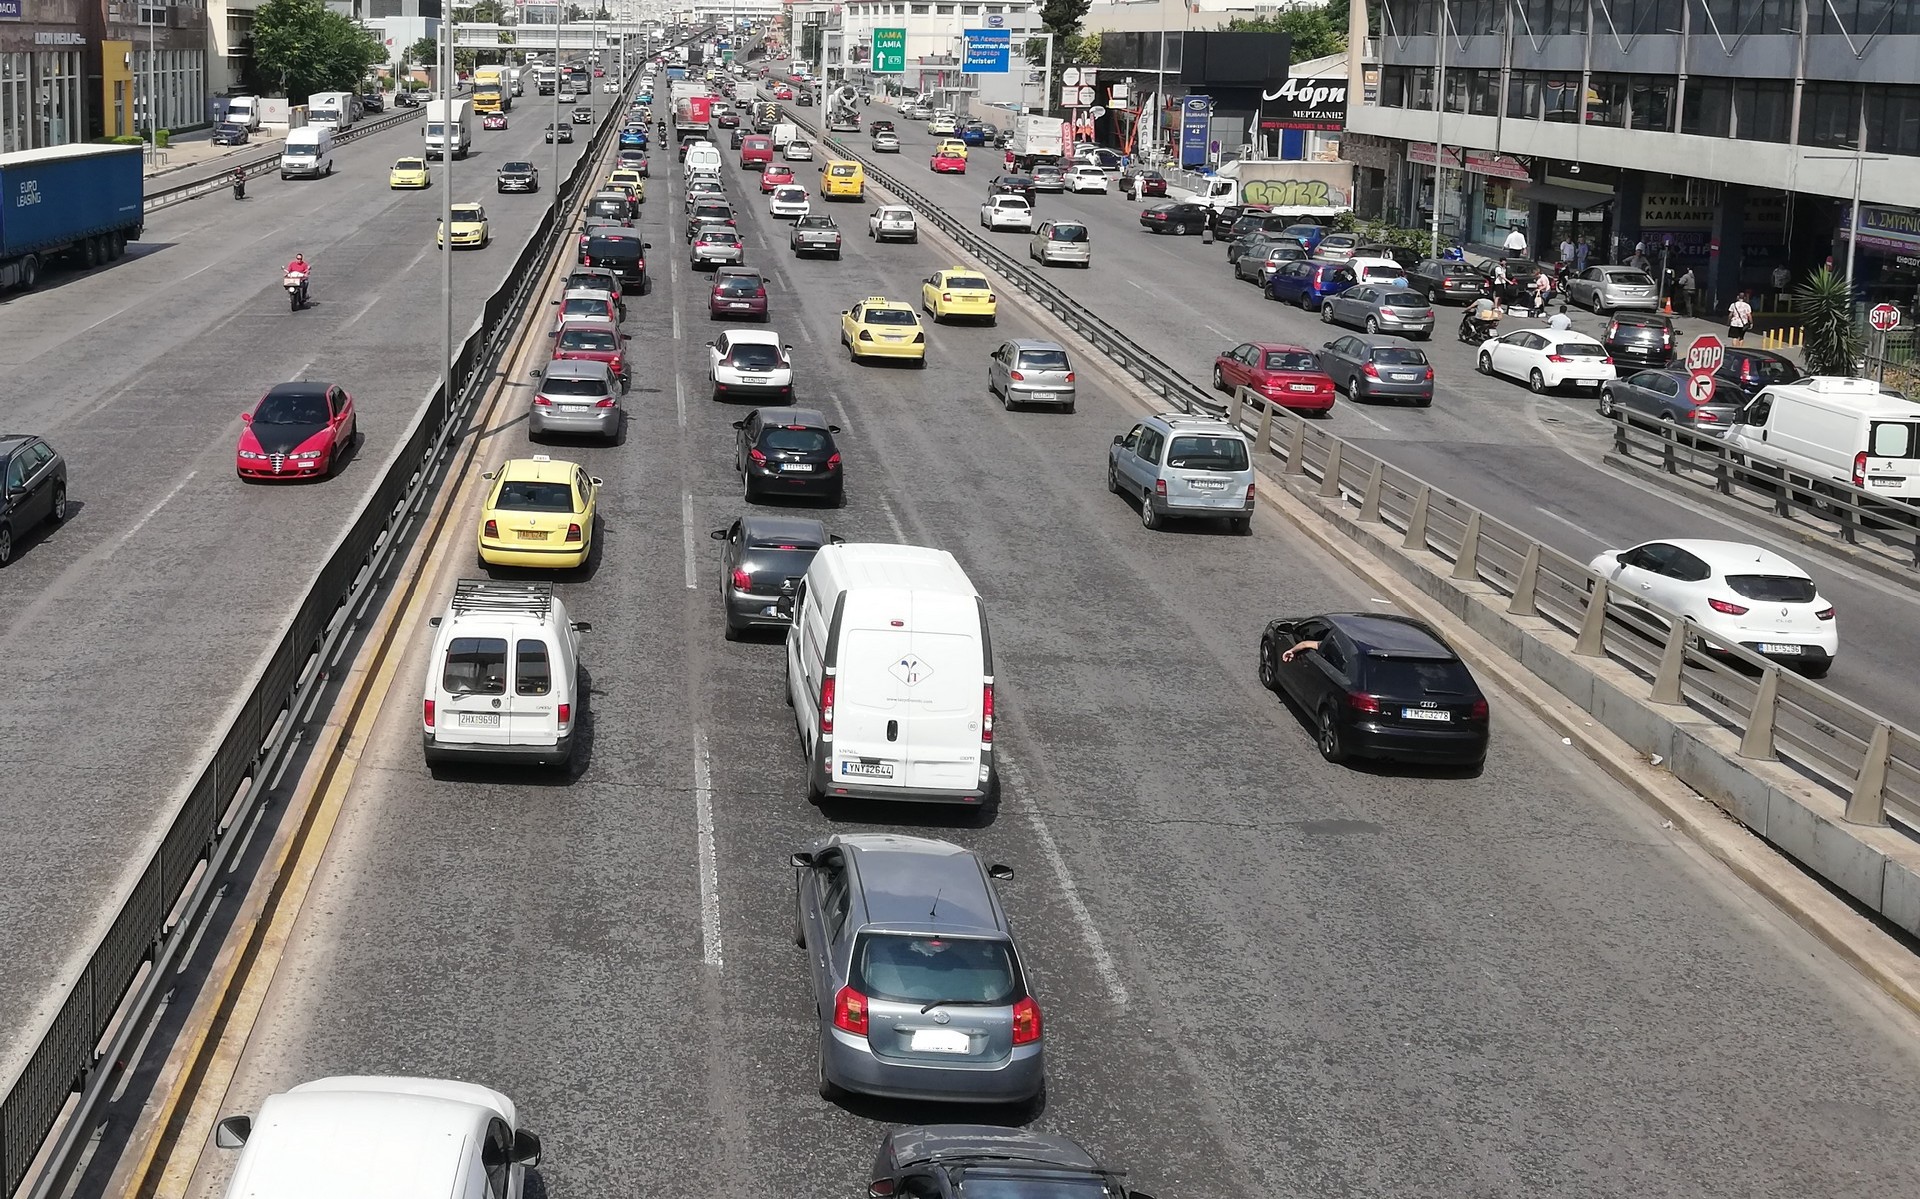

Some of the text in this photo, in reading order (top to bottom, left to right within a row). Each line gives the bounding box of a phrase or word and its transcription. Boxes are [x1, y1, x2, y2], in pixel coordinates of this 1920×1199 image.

[878, 31, 902, 39] ΛΑΜΙΑ
[877, 40, 901, 48] LAMIA
[967, 57, 996, 65] Peristeri
[1292, 110, 1344, 120] ΜΕΡΤΖΑΝΗΣ
[20, 180, 38, 193] EURO
[16, 192, 42, 207] LEASING
[1872, 310, 1898, 324] STOP
[1689, 346, 1721, 369] STOP
